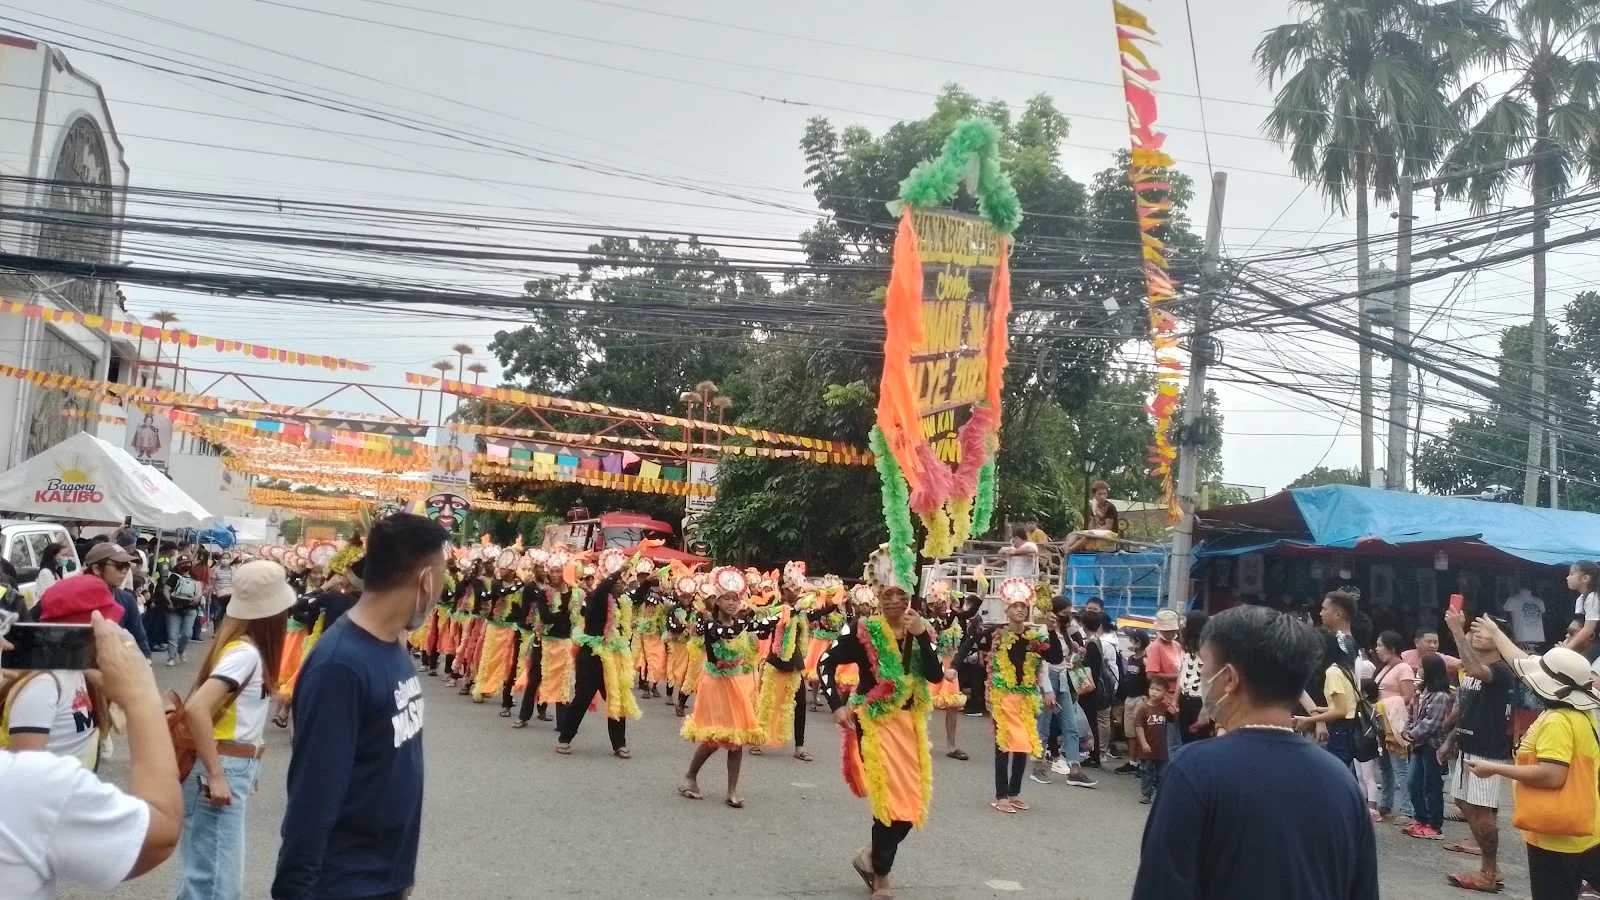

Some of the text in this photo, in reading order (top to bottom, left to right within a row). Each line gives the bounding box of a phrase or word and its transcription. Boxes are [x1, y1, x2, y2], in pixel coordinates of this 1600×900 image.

[949, 353, 988, 400] 2023
[937, 409, 955, 434] KAY
[34, 490, 104, 503] KALIBO
[48, 478, 96, 497] Bagong
